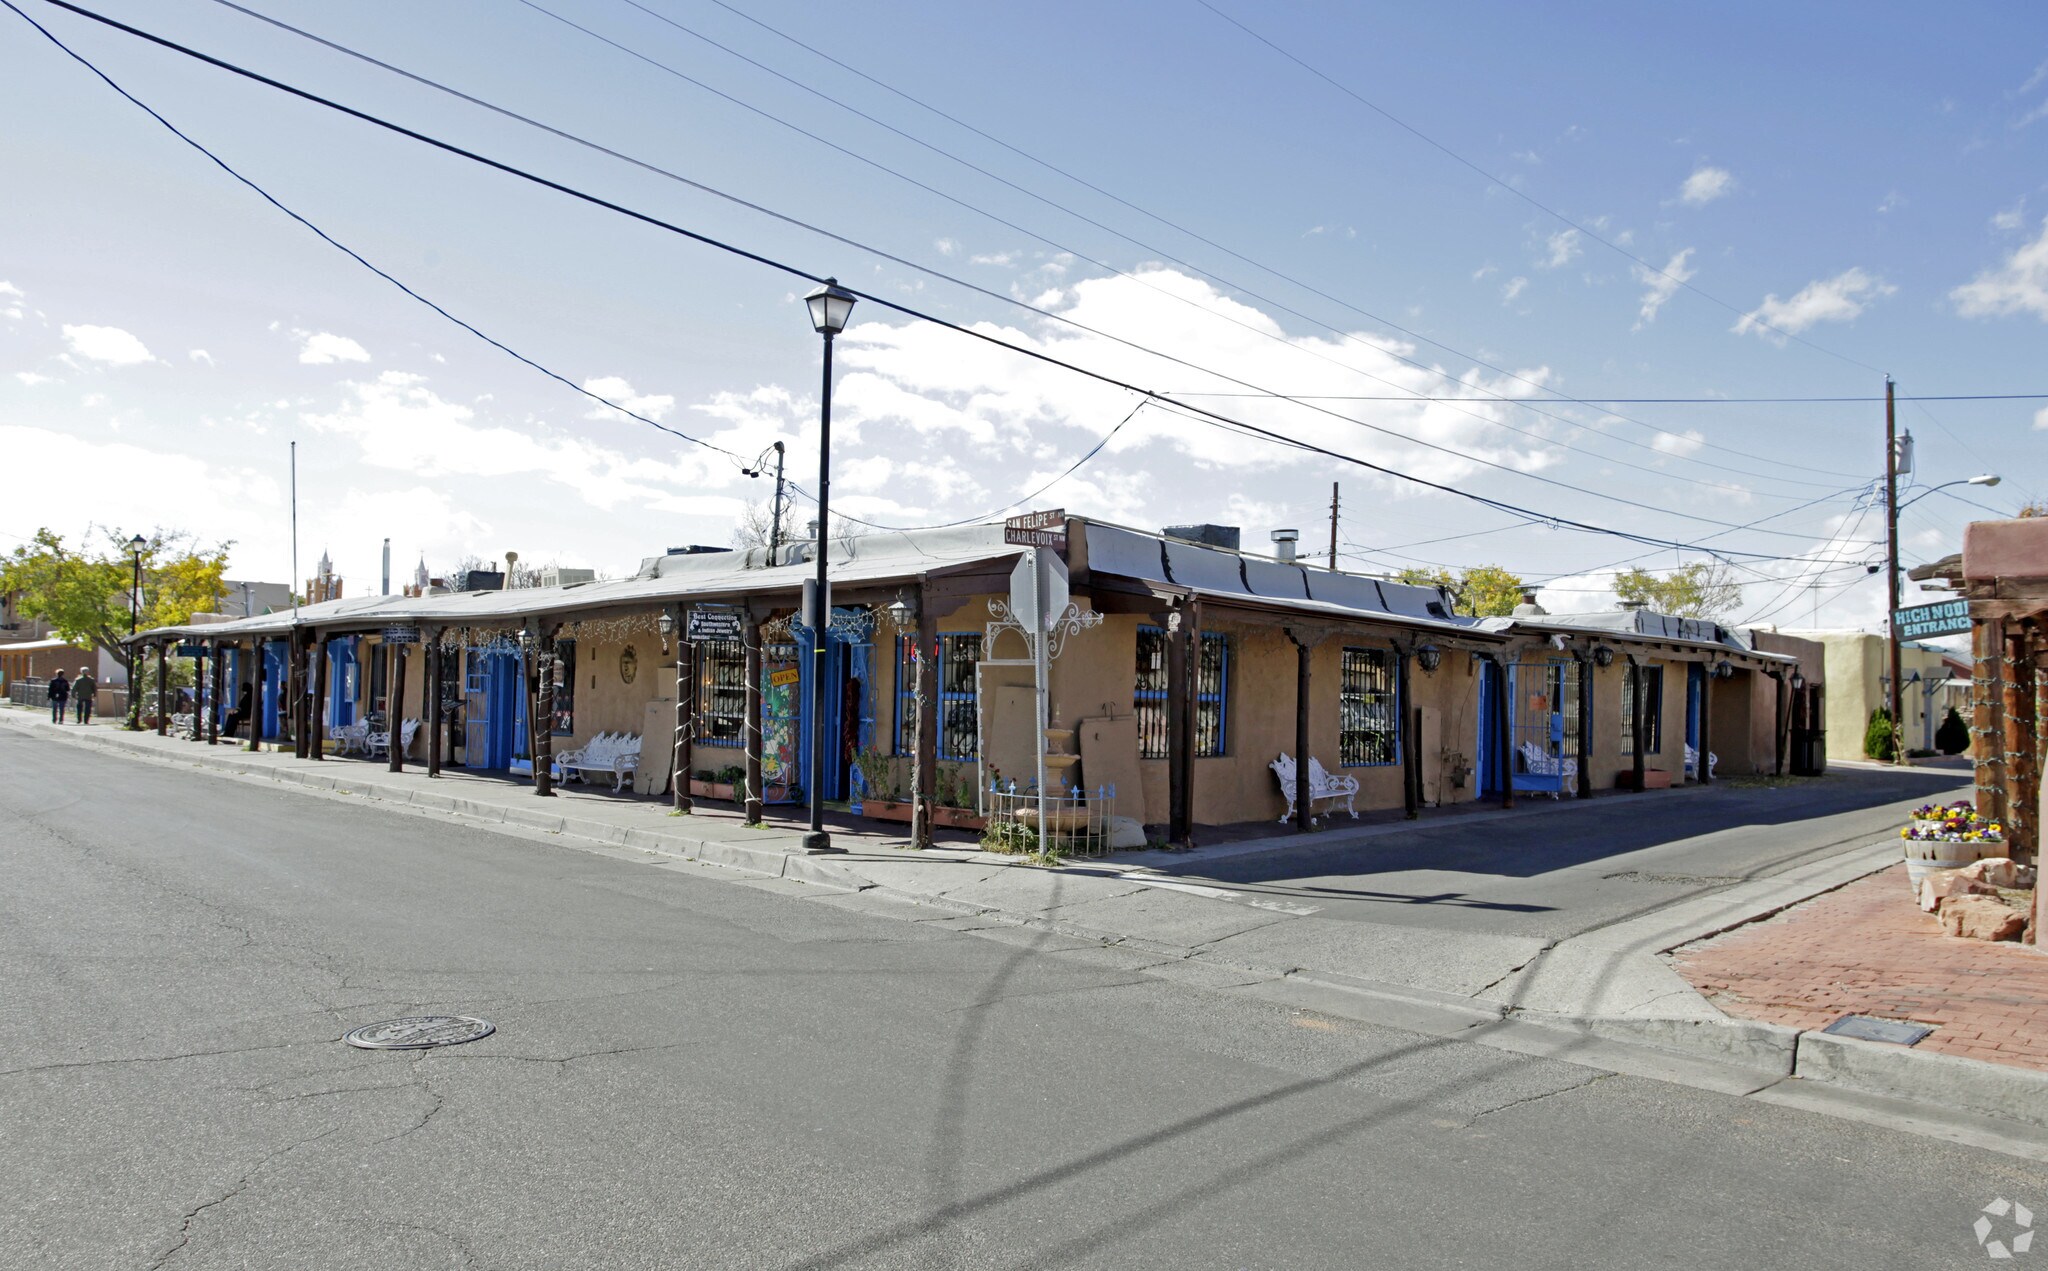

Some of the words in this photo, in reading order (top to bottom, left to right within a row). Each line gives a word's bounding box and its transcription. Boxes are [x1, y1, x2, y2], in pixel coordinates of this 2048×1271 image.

[1007, 518, 1021, 528] SAN
[1023, 513, 1048, 529] FELIPE
[1006, 529, 1053, 546] CHARLEVOIX
[773, 671, 797, 682] OPEN
